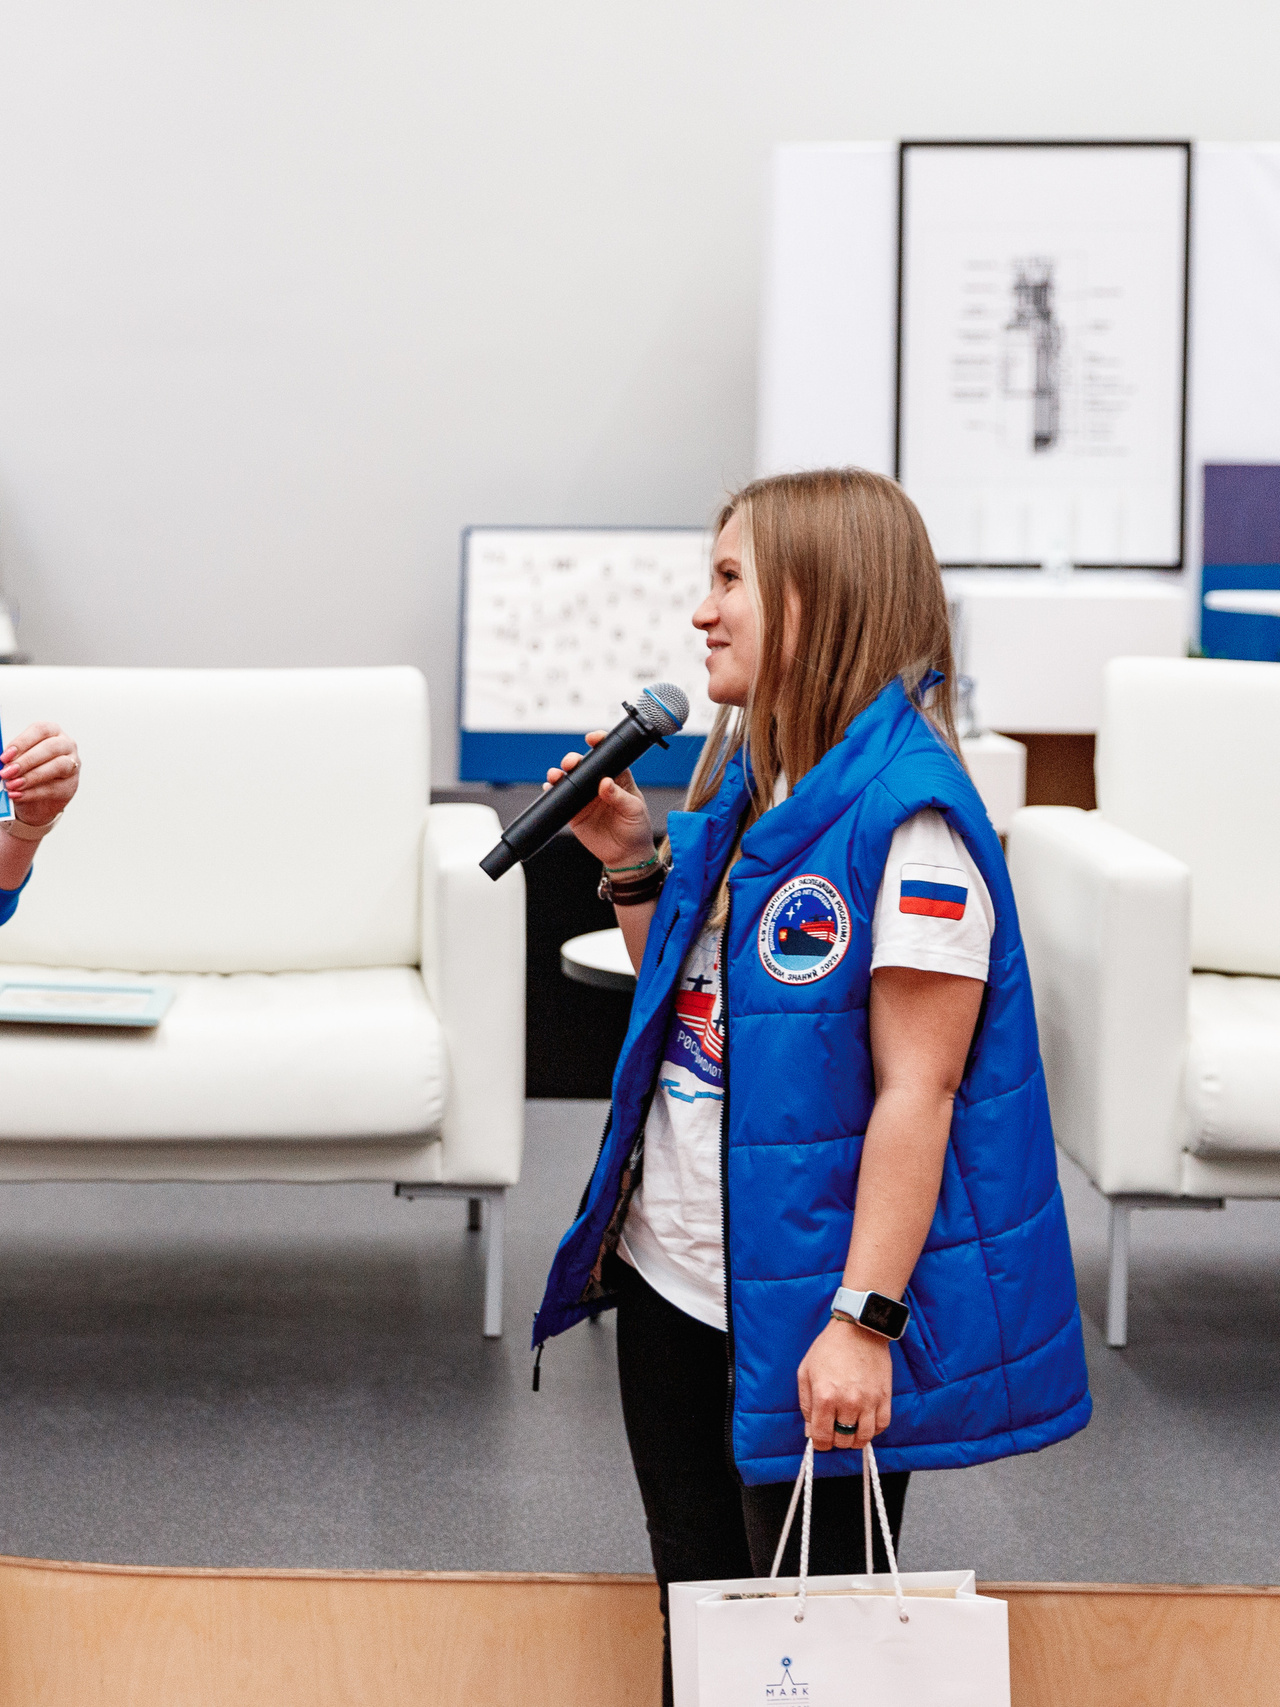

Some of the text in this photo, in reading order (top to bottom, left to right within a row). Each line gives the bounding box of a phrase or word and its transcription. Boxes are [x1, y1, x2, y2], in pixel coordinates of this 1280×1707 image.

[834, 900, 848, 943] РОСАТОМА
[787, 970, 819, 982] ЗНАНИЙ
[766, 1687, 809, 1697] МАЯК
